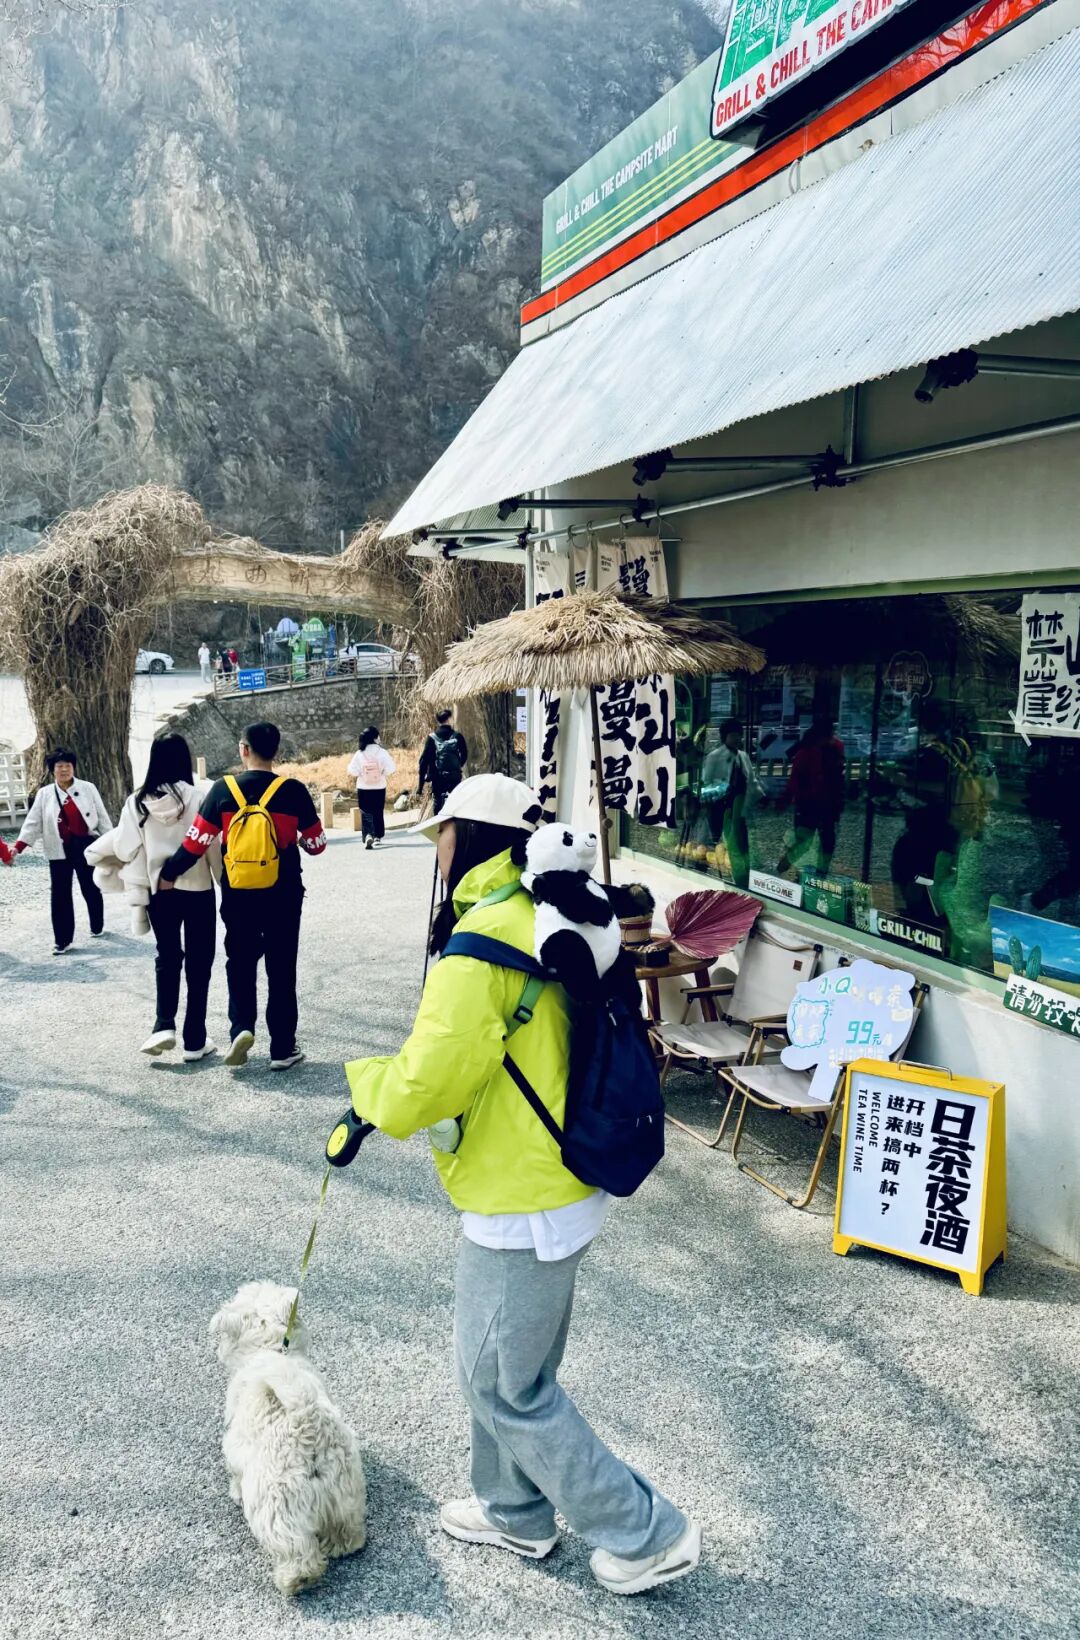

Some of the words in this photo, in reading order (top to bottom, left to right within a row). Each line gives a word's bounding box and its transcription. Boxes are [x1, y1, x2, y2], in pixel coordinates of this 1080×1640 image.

[715, 83, 752, 127] GRILL
[755, 72, 766, 100] &
[770, 39, 810, 89] CHILL
[816, 10, 848, 56] THE
[556, 208, 574, 235] GRILL
[580, 188, 600, 216] CHILL
[600, 175, 615, 201] THE
[615, 144, 654, 190] CAMPSITE
[654, 124, 678, 161] MART
[753, 879, 793, 898] WELCOME
[855, 1112, 866, 1141] WINE
[858, 1088, 868, 1109] TEA
[868, 1090, 882, 1148] WELCOME
[903, 1097, 926, 1158] 开档中
[852, 1145, 864, 1174] TIME
[919, 1098, 977, 1255] 日茶夜酒
